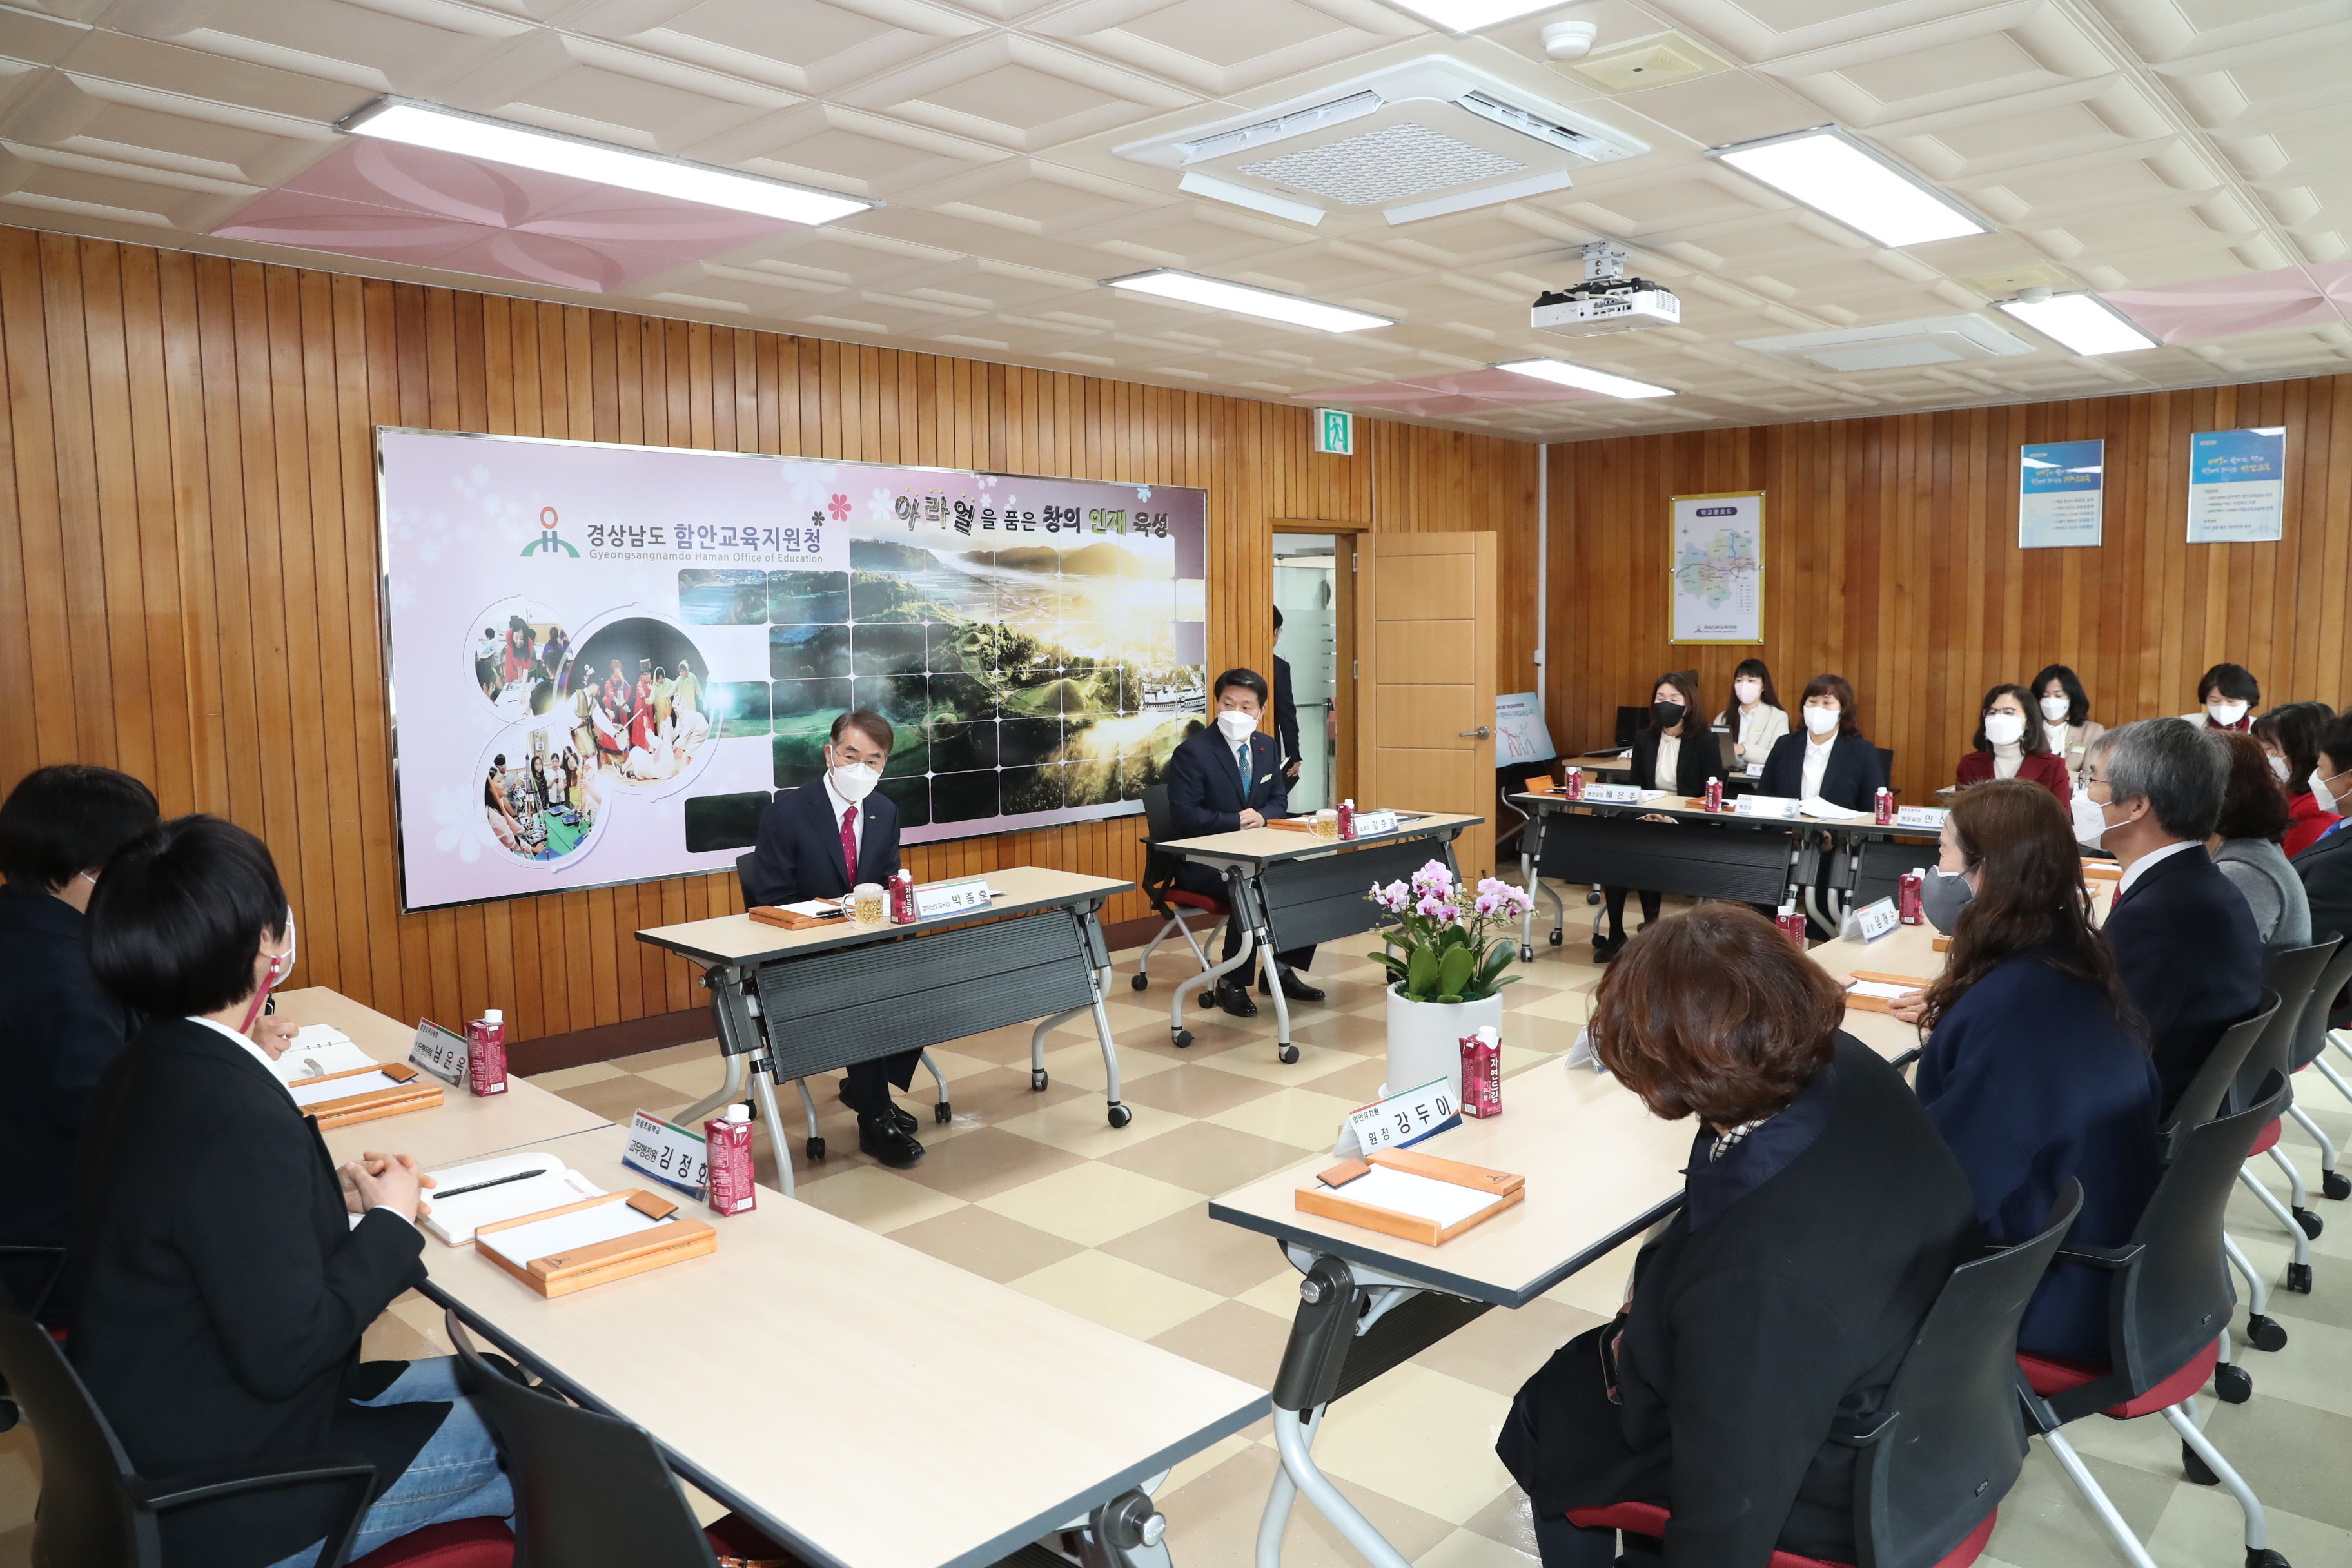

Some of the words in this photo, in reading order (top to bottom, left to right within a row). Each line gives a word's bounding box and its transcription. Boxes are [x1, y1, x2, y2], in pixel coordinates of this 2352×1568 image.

[1004, 510, 1037, 532] 품은
[1043, 505, 1081, 534] 창의
[1088, 508, 1126, 536] 인재
[1133, 511, 1168, 538] 육성
[587, 524, 667, 547] 경상남도
[673, 523, 821, 553] 함안교육지원청
[589, 549, 691, 562] Gyeongsangnamdo
[695, 551, 729, 562] Haman
[733, 552, 761, 563] Office
[765, 553, 774, 562] of
[778, 553, 823, 564] Education
[1490, 1057, 1499, 1103] 자연드림
[635, 1118, 662, 1135] 외암초등학교
[629, 1139, 658, 1163] 교무행정원
